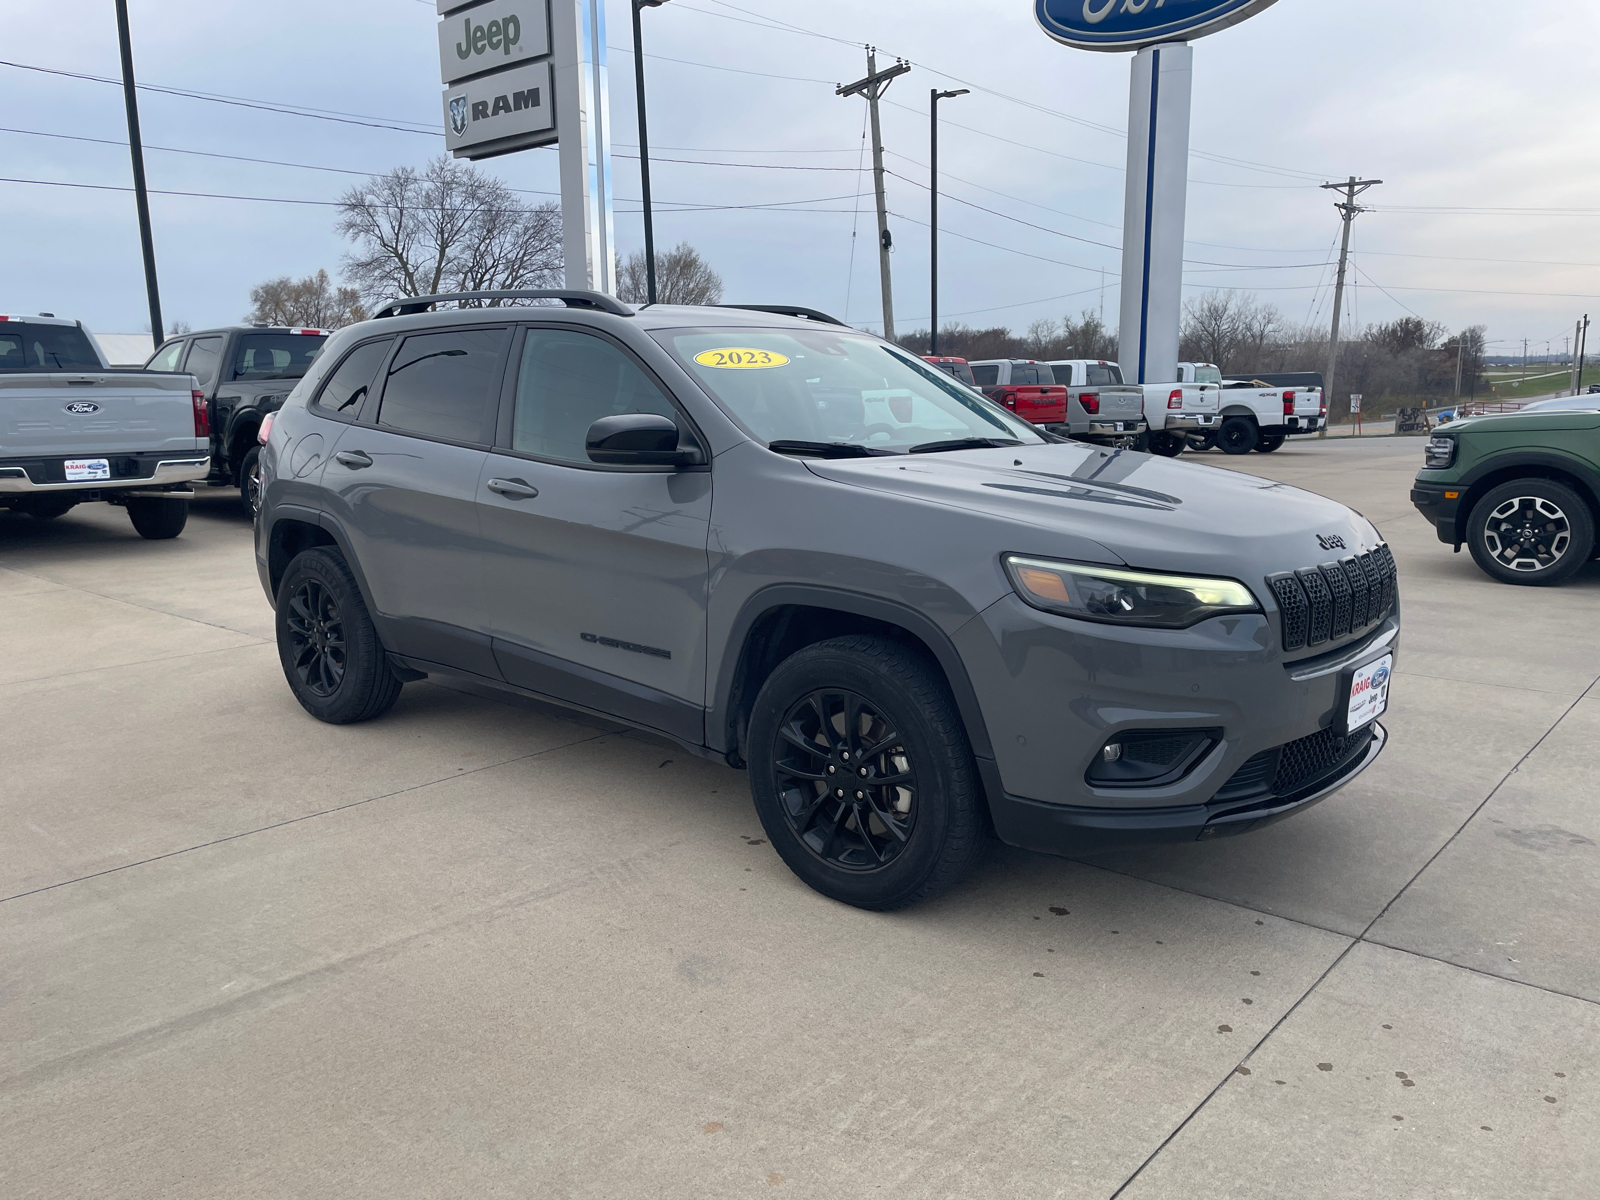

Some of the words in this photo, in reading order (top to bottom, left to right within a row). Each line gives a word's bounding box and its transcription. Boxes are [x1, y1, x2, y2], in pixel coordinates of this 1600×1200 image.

[456, 14, 520, 60] Jeep
[471, 87, 541, 121] RAM
[712, 351, 772, 366] 2023
[71, 403, 94, 413] Ford
[1033, 398, 1056, 406] RAM
[1316, 534, 1347, 550] Jeep
[579, 632, 672, 660] CHEROKEE
[1350, 676, 1371, 699] KRAIG
[1368, 692, 1378, 705] Jeep
